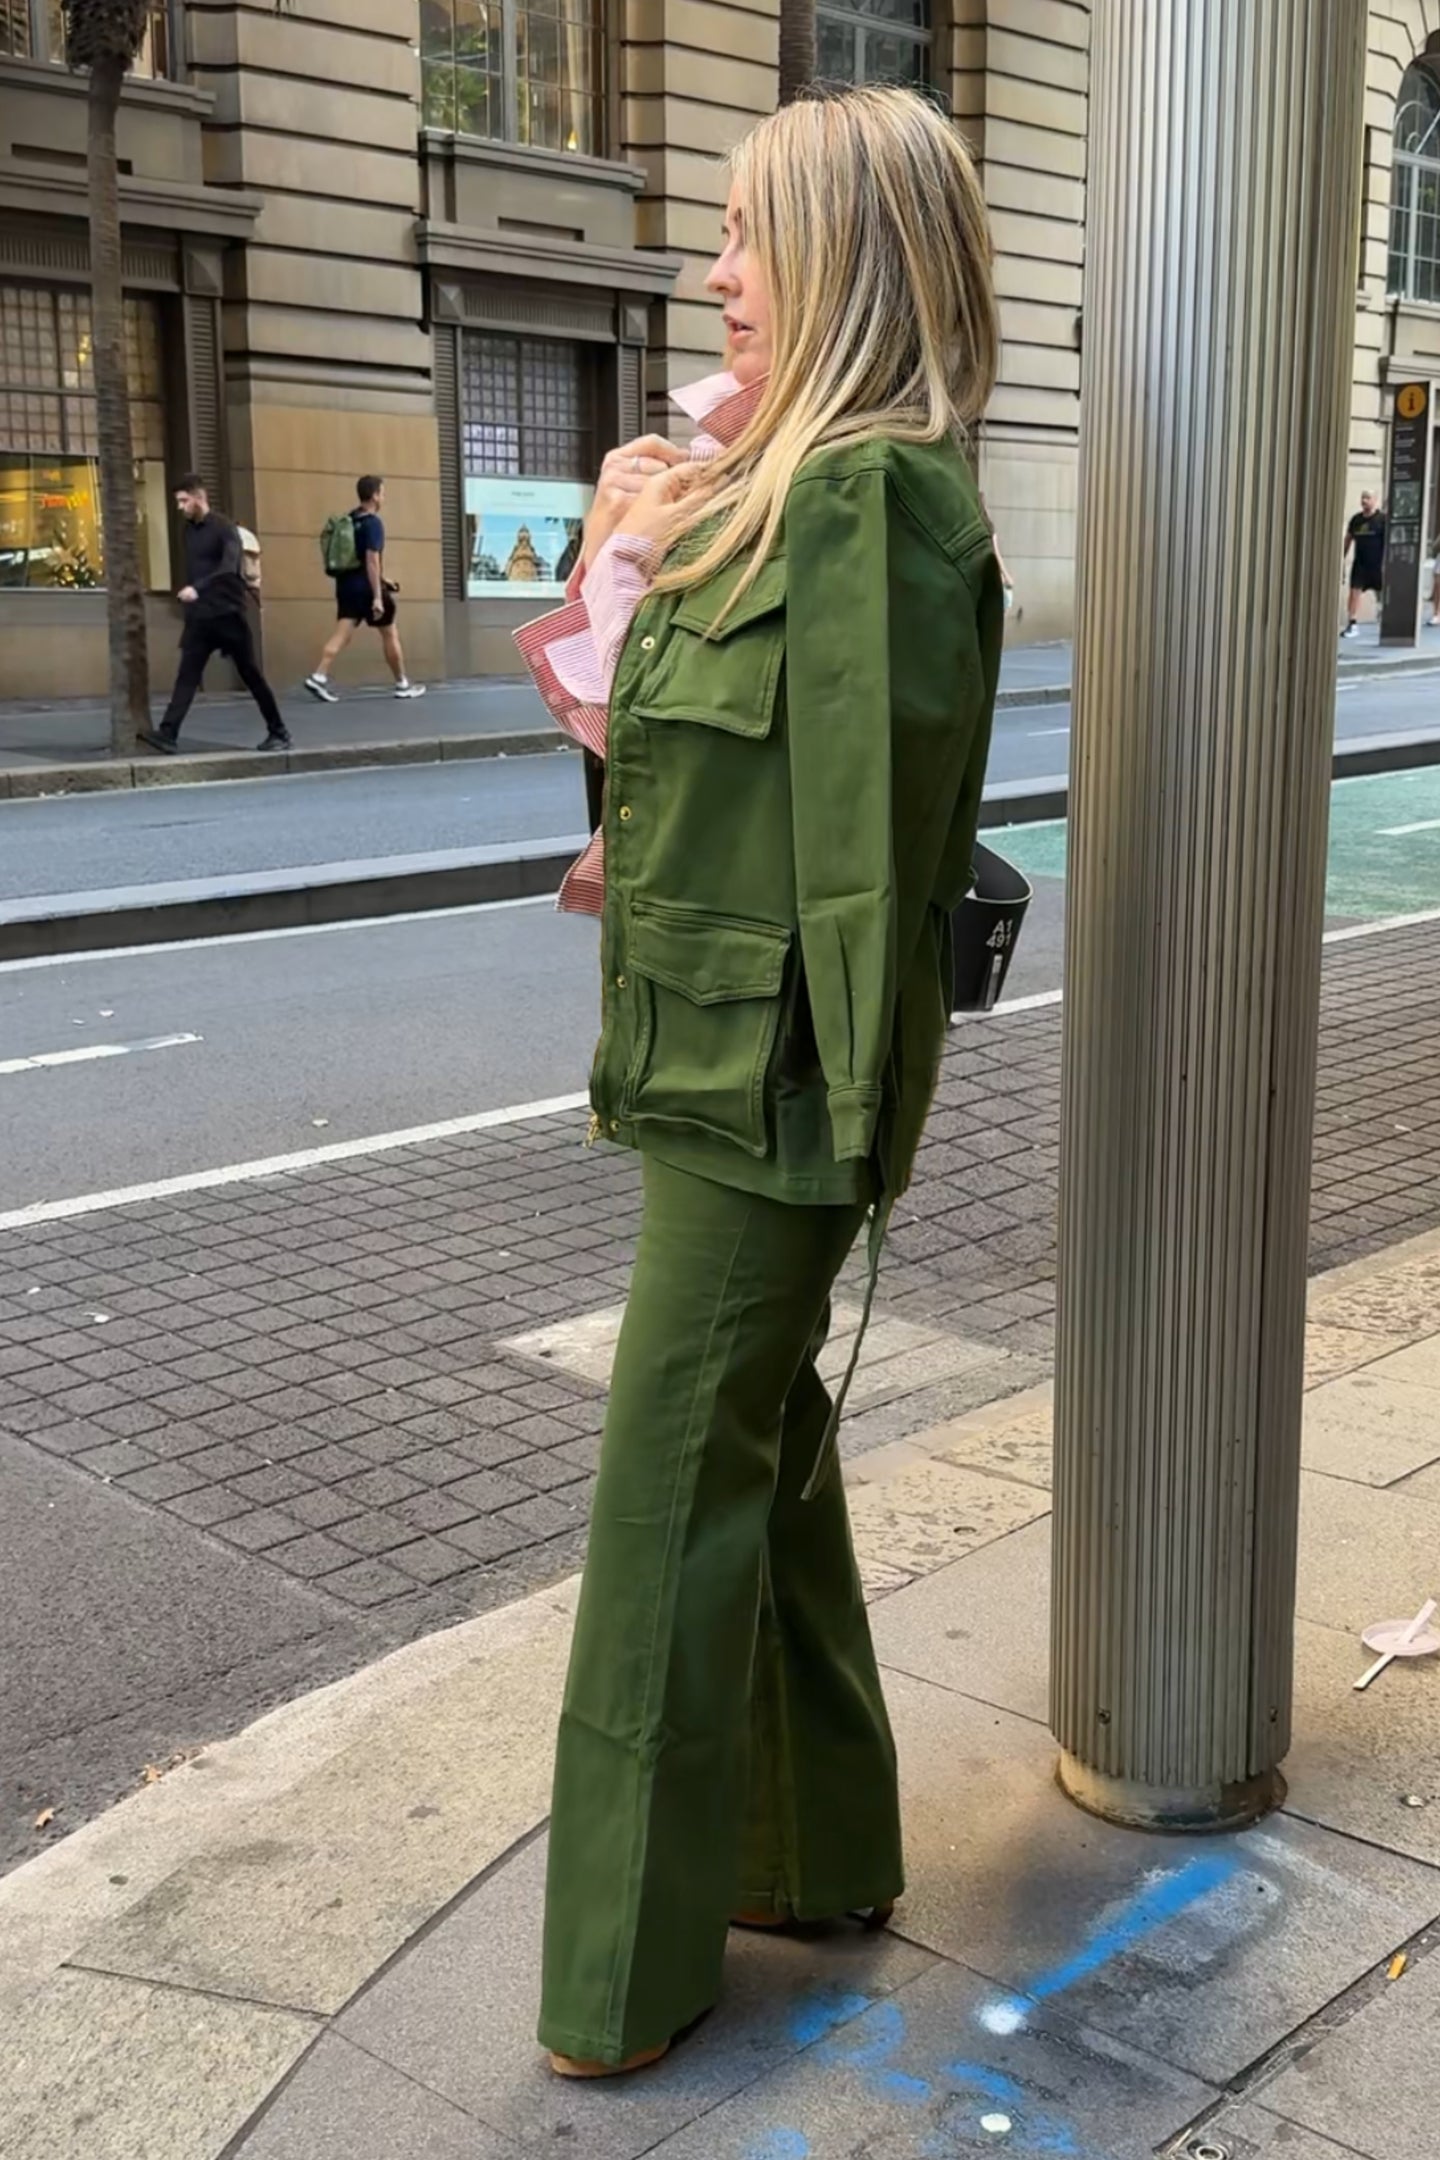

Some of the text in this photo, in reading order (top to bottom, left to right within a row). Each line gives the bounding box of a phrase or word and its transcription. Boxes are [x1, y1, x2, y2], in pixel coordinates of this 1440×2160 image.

[1407, 391, 1416, 412] i
[992, 919, 1013, 934] A1
[985, 933, 1012, 947] 491
